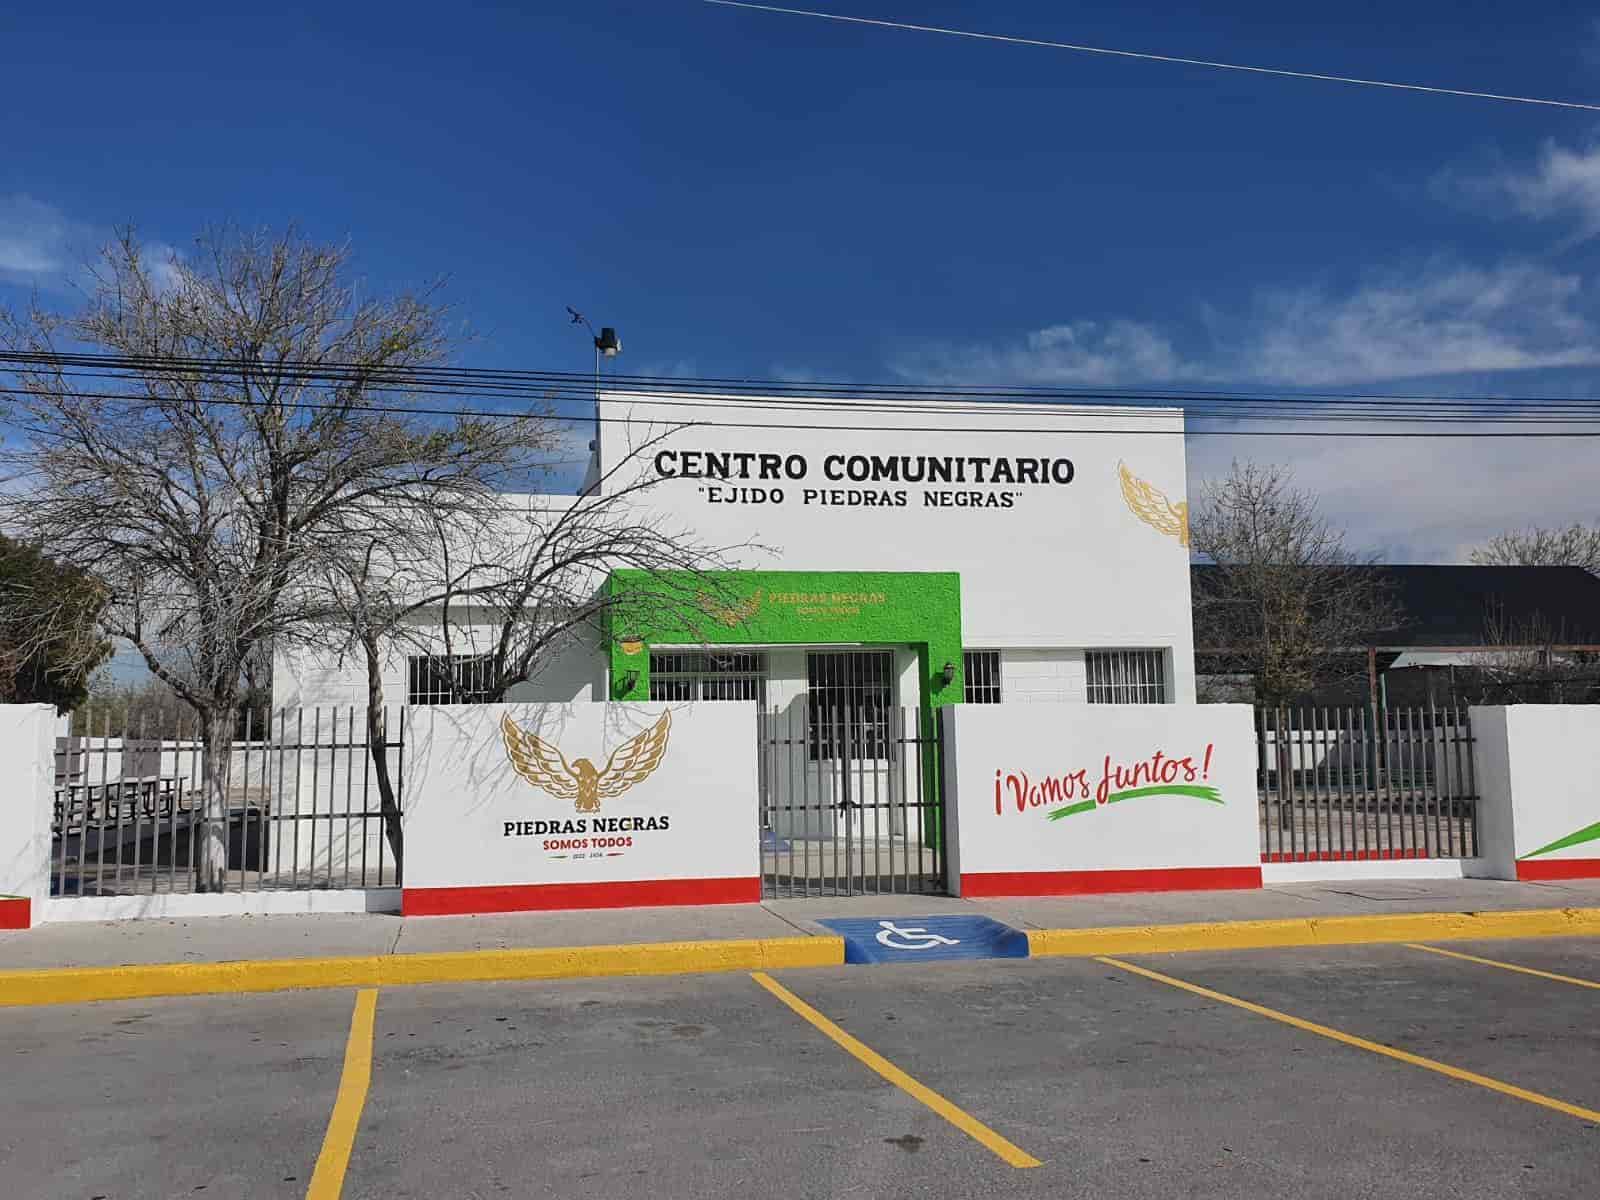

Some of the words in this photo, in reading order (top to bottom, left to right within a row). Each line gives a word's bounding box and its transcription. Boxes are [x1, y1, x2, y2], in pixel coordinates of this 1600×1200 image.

[655, 450, 808, 480] CENTRO
[824, 454, 1075, 485] COMUNITARIO
[699, 487, 785, 504] "EJIDO
[803, 489, 907, 506] PIEDRAS
[923, 491, 1023, 508] NEGRAS"
[503, 819, 587, 837] PIEDRAS
[592, 815, 670, 833] NEGRAS
[543, 839, 588, 851] SOMOS
[592, 836, 633, 849] TODOS
